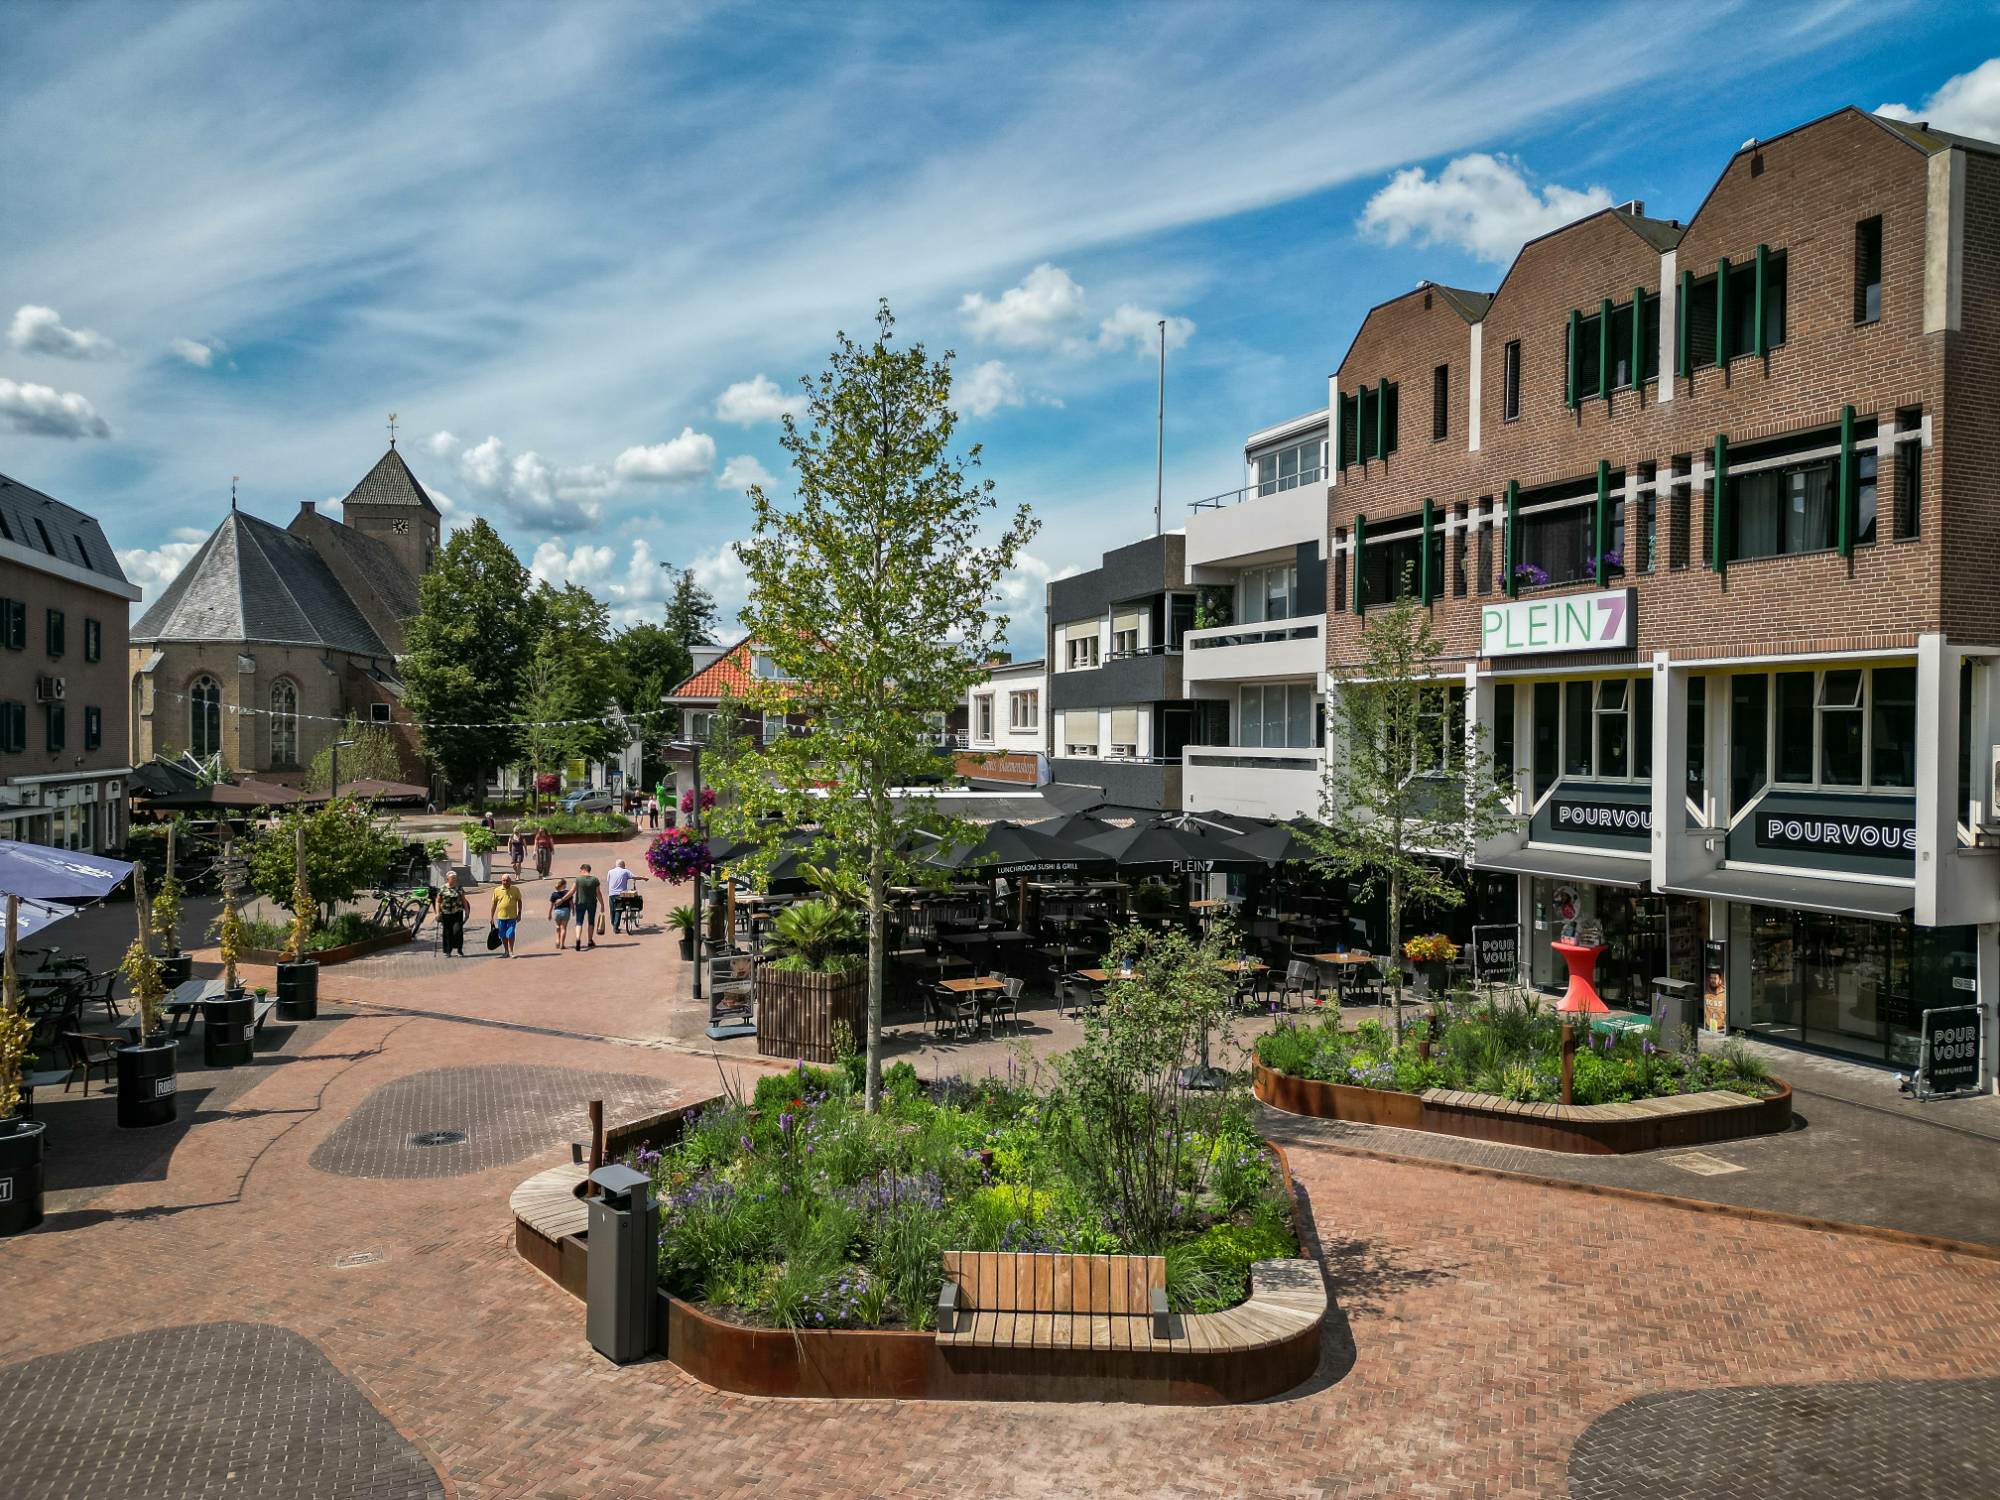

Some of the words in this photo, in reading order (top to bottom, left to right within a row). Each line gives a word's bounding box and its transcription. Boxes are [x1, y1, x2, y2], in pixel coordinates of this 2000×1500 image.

[1768, 820, 1917, 850] POURVOUS
[997, 864, 1037, 874] LUNCHROOM
[1038, 863, 1055, 871] SUSHI
[1172, 861, 1214, 873] PLEIN7
[1482, 939, 1515, 952] POUR
[1482, 951, 1514, 964] VOUS
[1933, 1026, 1976, 1045] POUR
[1933, 1042, 1976, 1061] VOUS
[1934, 1065, 1974, 1076] PARFUMERIE
